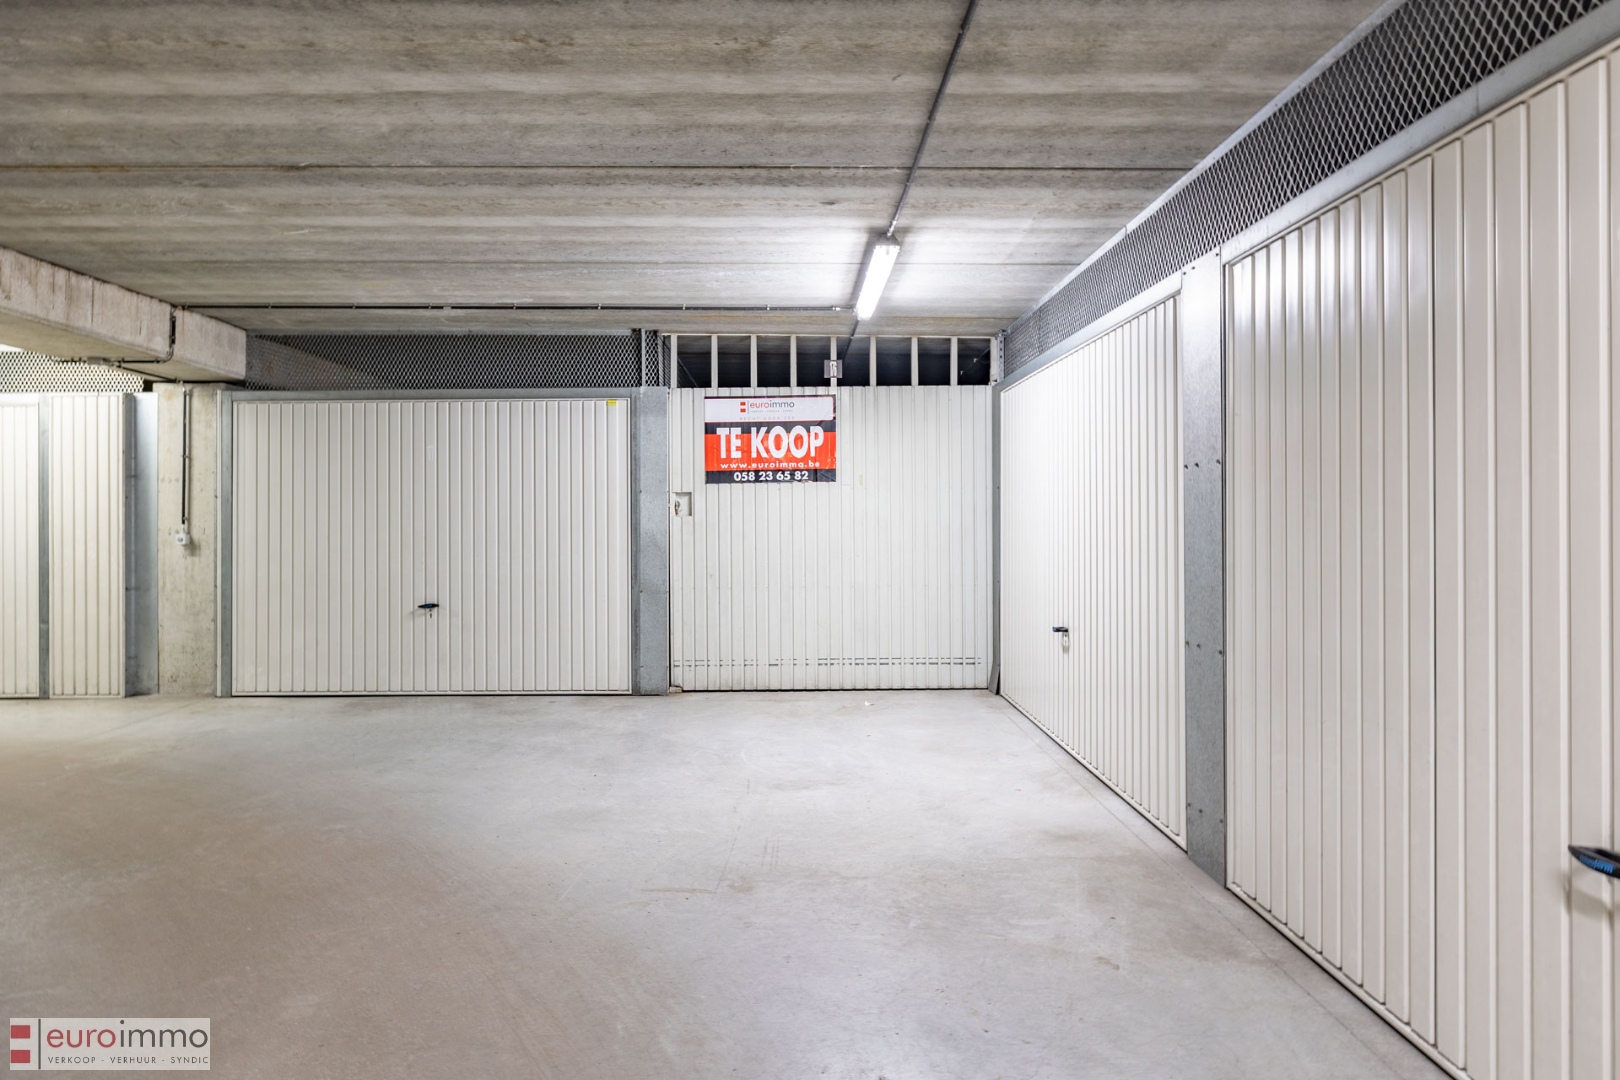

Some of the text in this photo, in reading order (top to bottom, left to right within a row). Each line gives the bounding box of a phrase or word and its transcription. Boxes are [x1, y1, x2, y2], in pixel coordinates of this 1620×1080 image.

[750, 400, 795, 408] euroimmo
[716, 425, 825, 459] TE KOOP
[720, 460, 820, 469] www.euroimmo.be
[733, 471, 809, 481] 058 23 65 82
